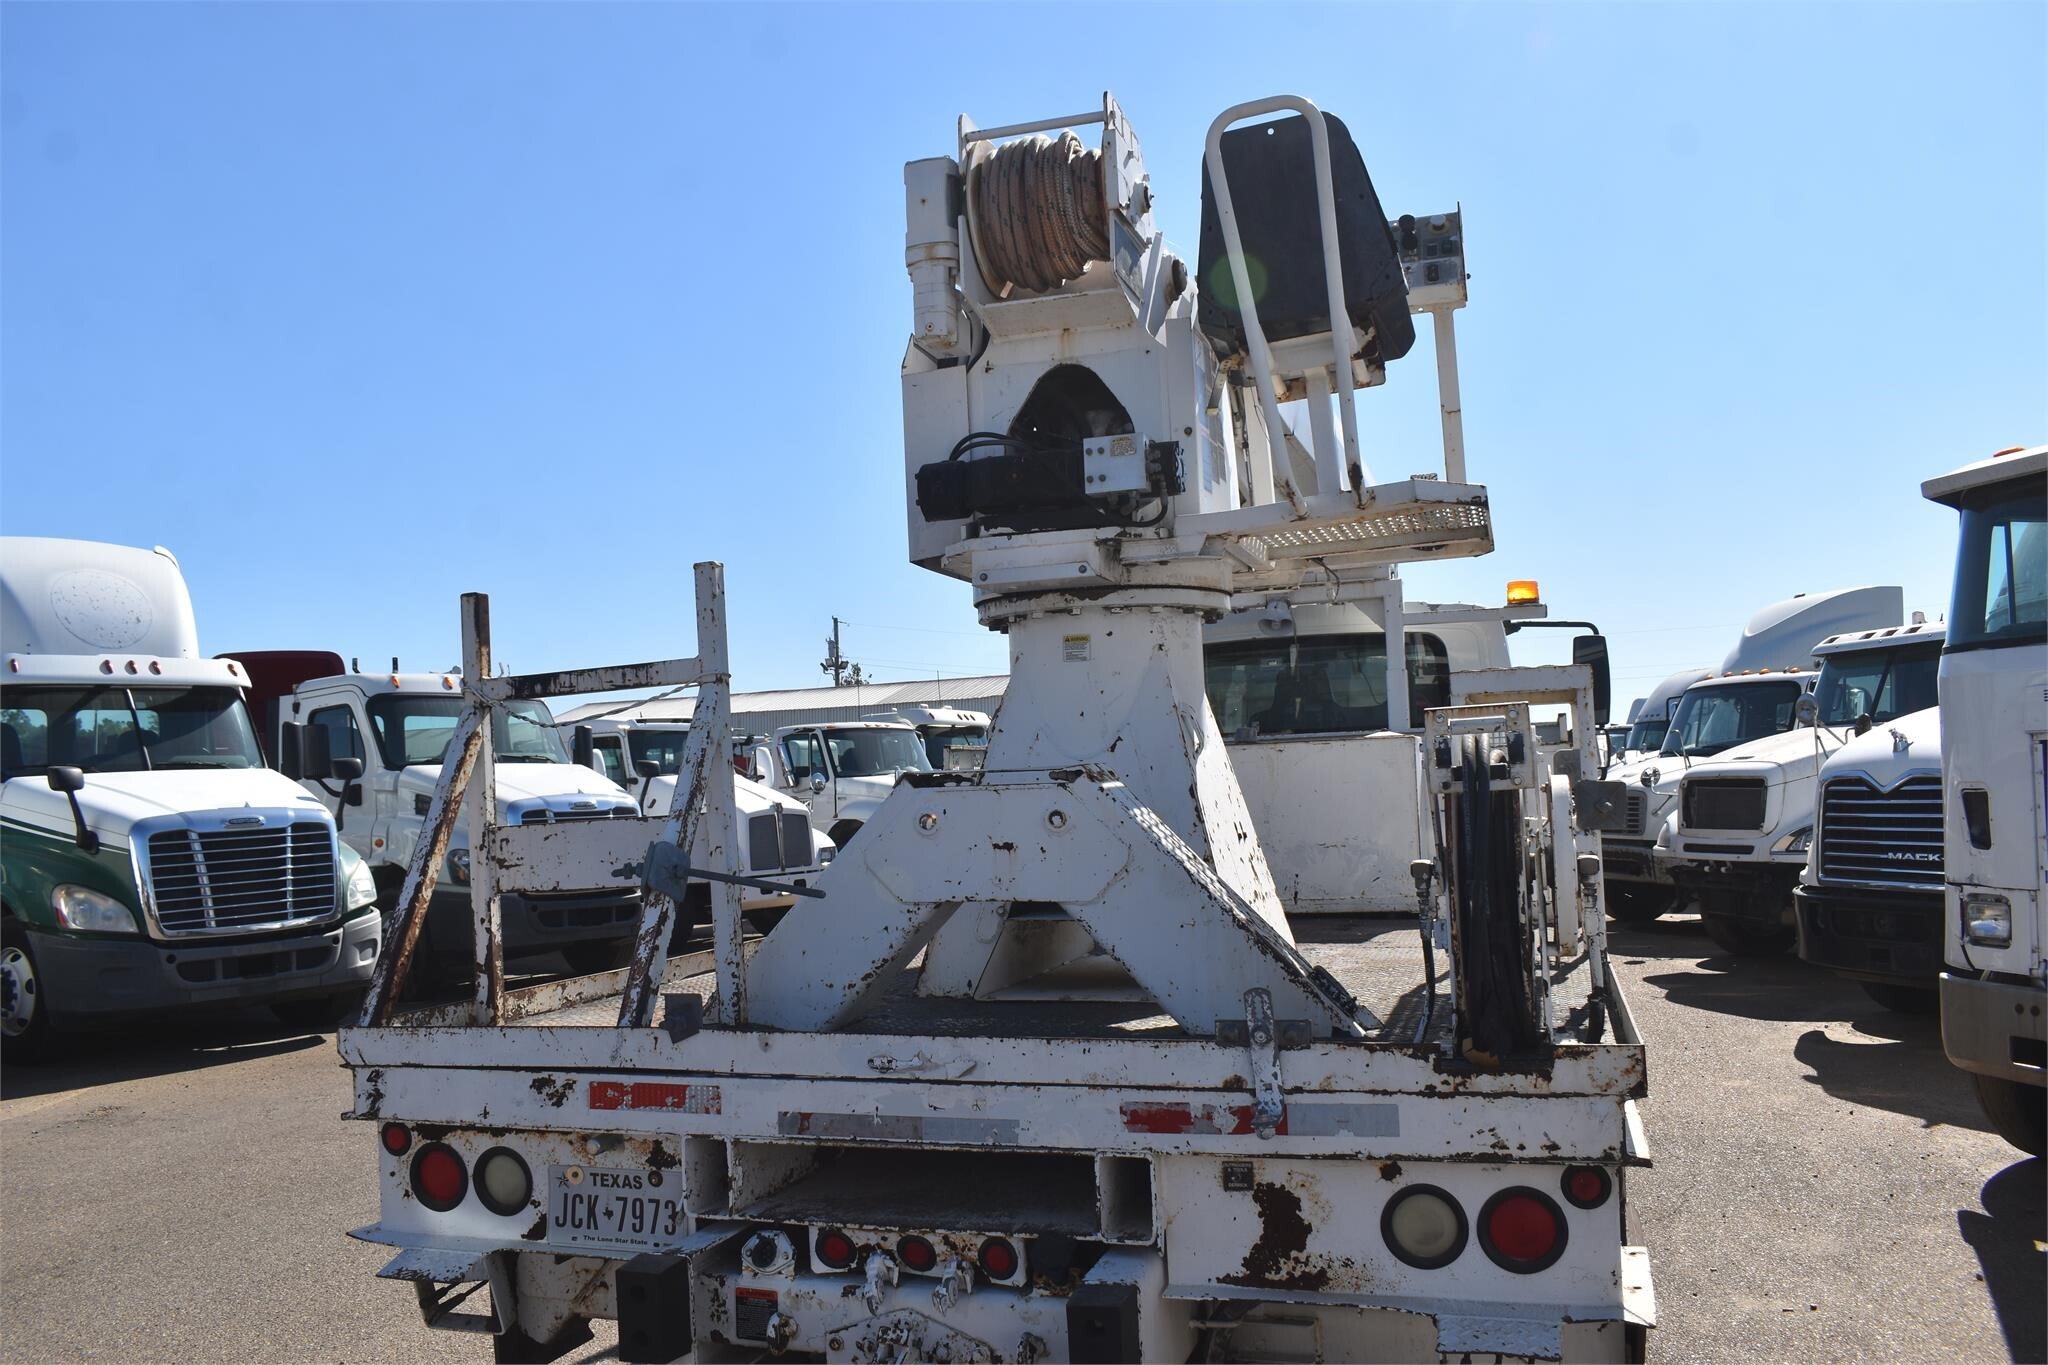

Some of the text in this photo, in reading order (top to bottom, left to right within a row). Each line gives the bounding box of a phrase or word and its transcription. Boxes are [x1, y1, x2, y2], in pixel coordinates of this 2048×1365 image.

[1887, 852, 1941, 861] MACK
[589, 1172, 643, 1189] TEXAS
[554, 1192, 677, 1236] JCK 7973
